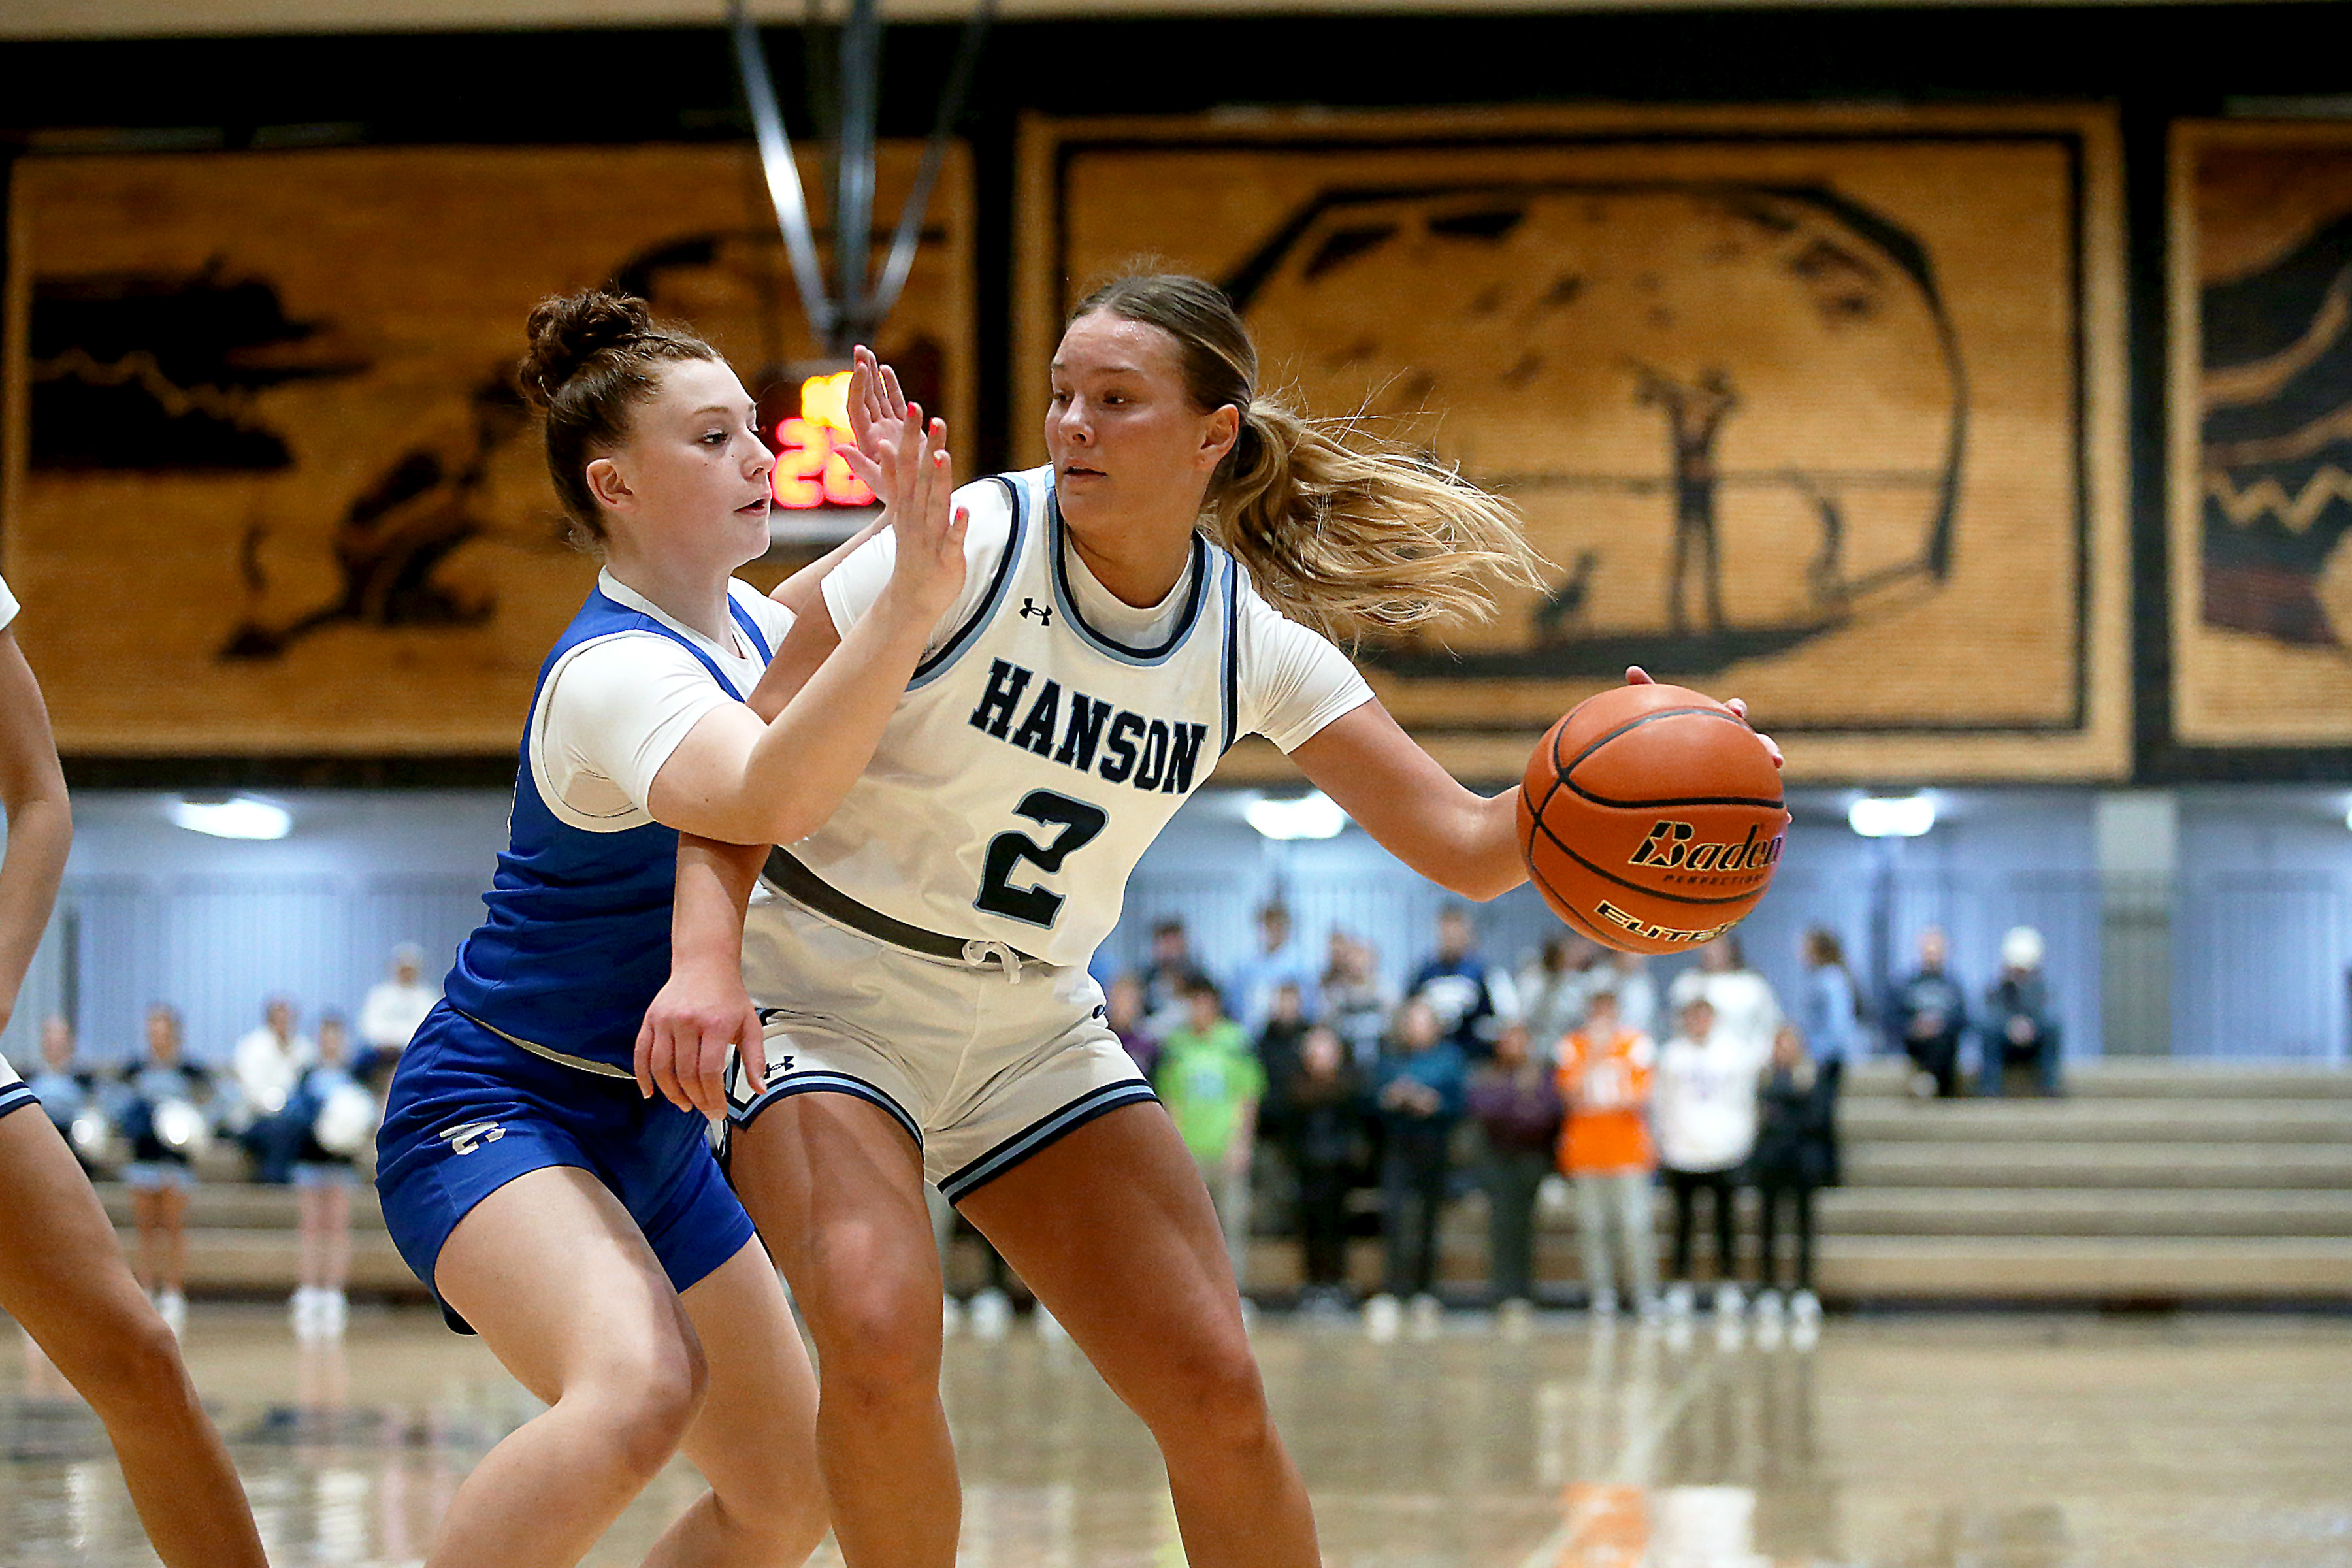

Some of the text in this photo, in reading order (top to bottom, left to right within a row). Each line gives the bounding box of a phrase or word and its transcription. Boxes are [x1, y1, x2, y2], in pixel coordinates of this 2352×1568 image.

[968, 657, 1209, 794] HANSON
[972, 788, 1109, 930] 2
[1628, 819, 1783, 871] Baden
